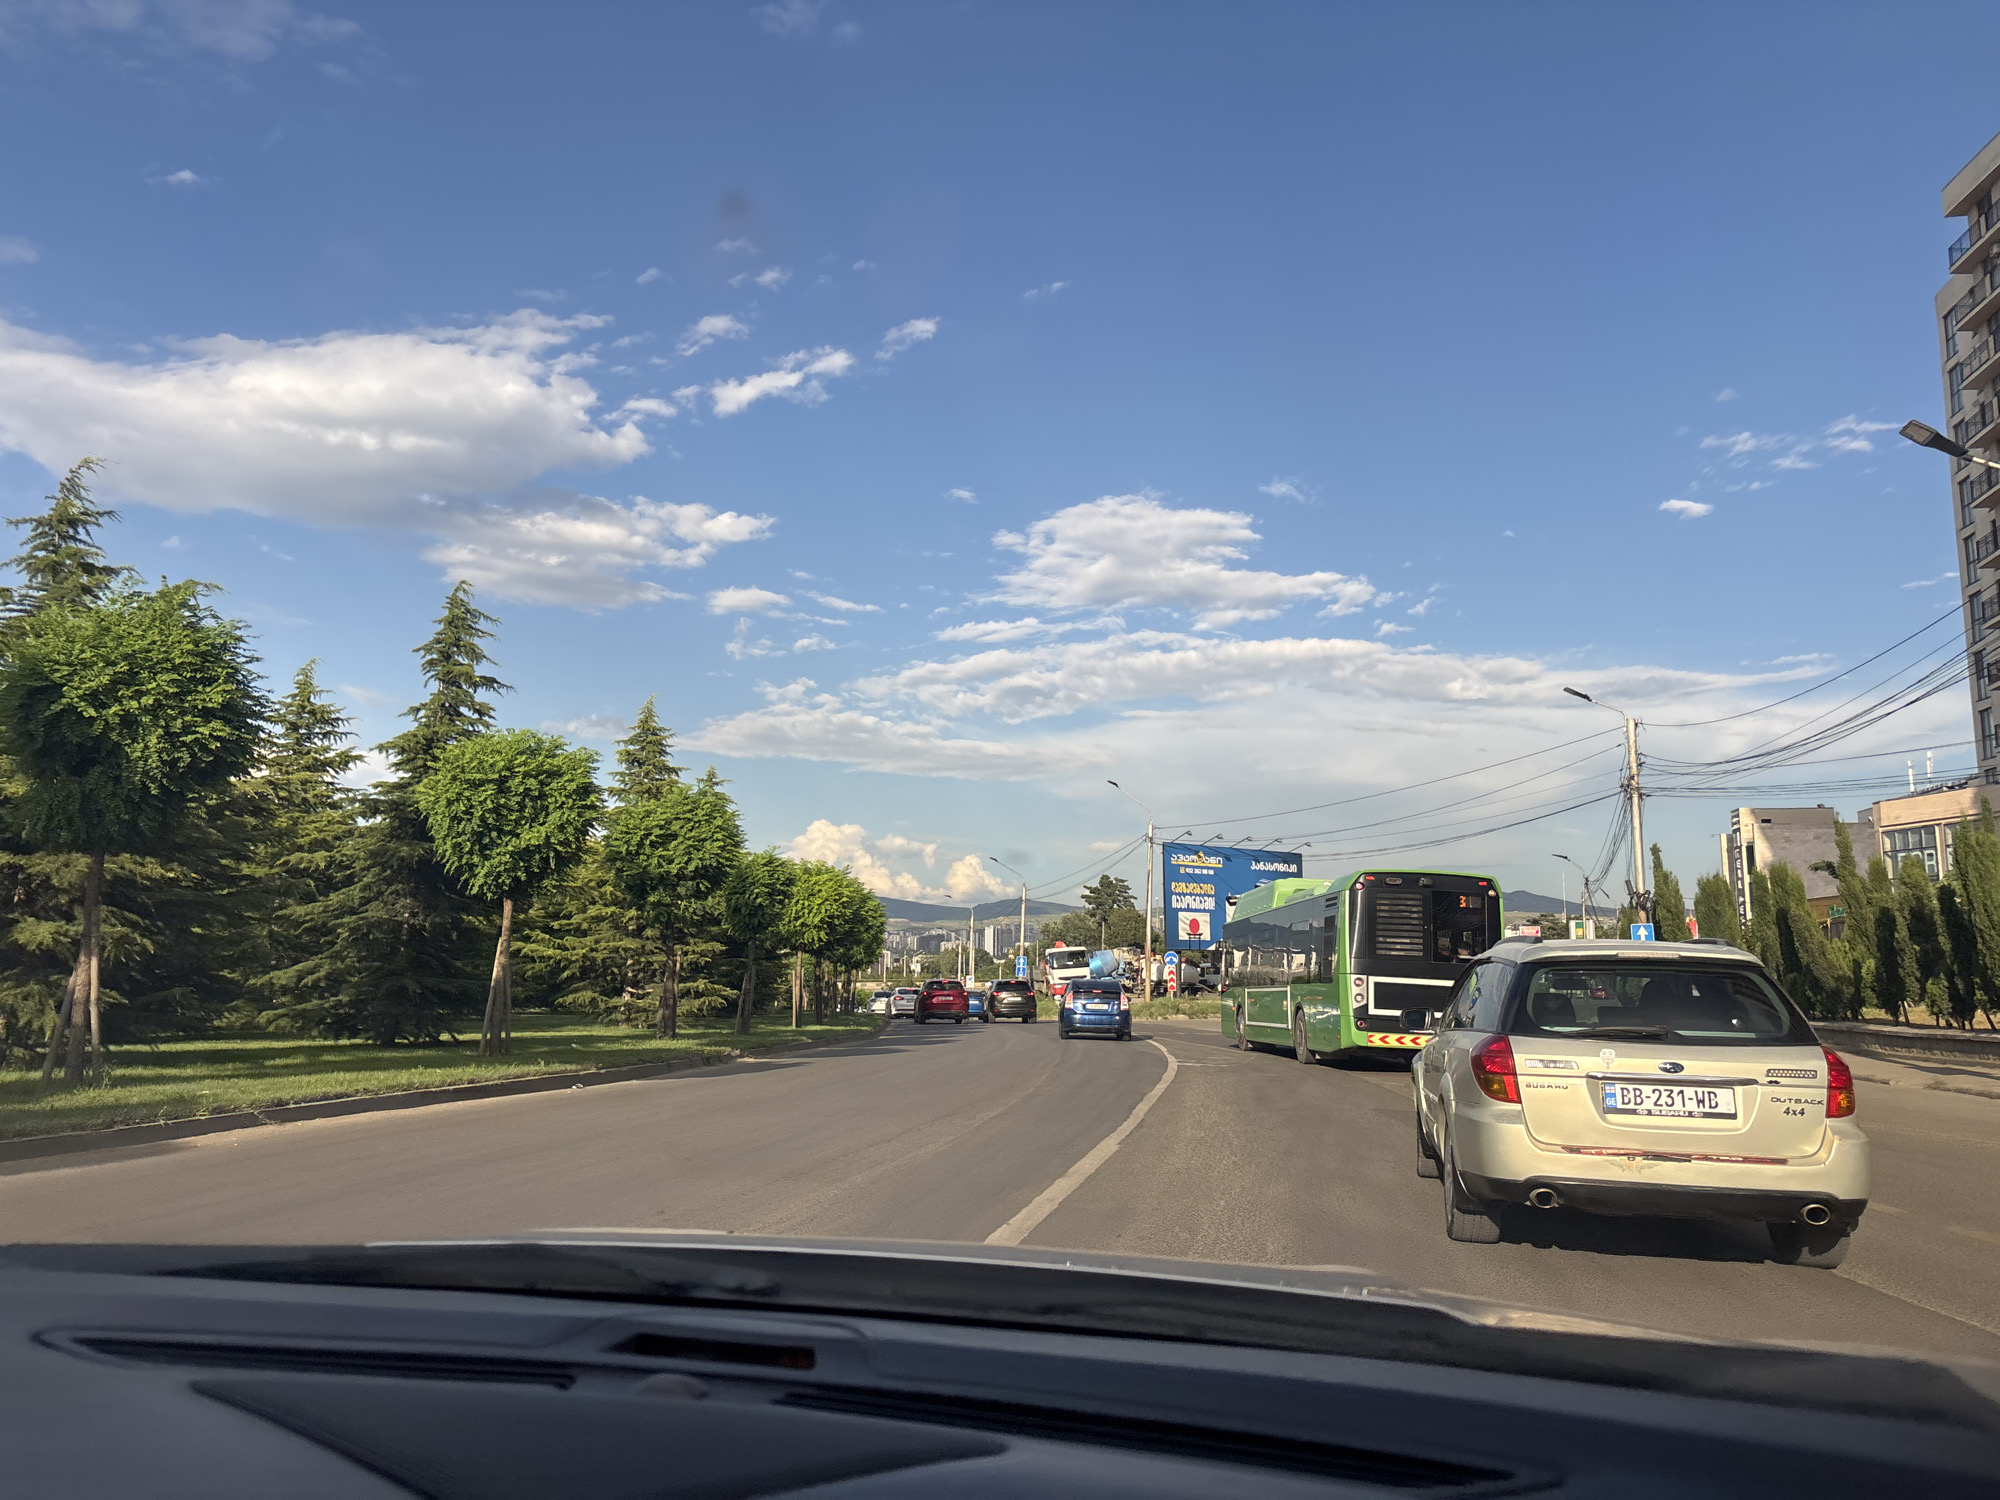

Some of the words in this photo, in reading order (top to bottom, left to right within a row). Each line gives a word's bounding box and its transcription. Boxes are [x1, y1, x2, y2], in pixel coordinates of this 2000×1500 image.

[1250, 860, 1298, 873] პანასონიკი
[1171, 881, 1215, 895] დამზადებულია
[1171, 894, 1216, 910] იაპონიაში!
[1606, 1097, 1617, 1106] GE
[1770, 1096, 1825, 1106] OUTBACK
[1783, 1106, 1806, 1117] 4x4
